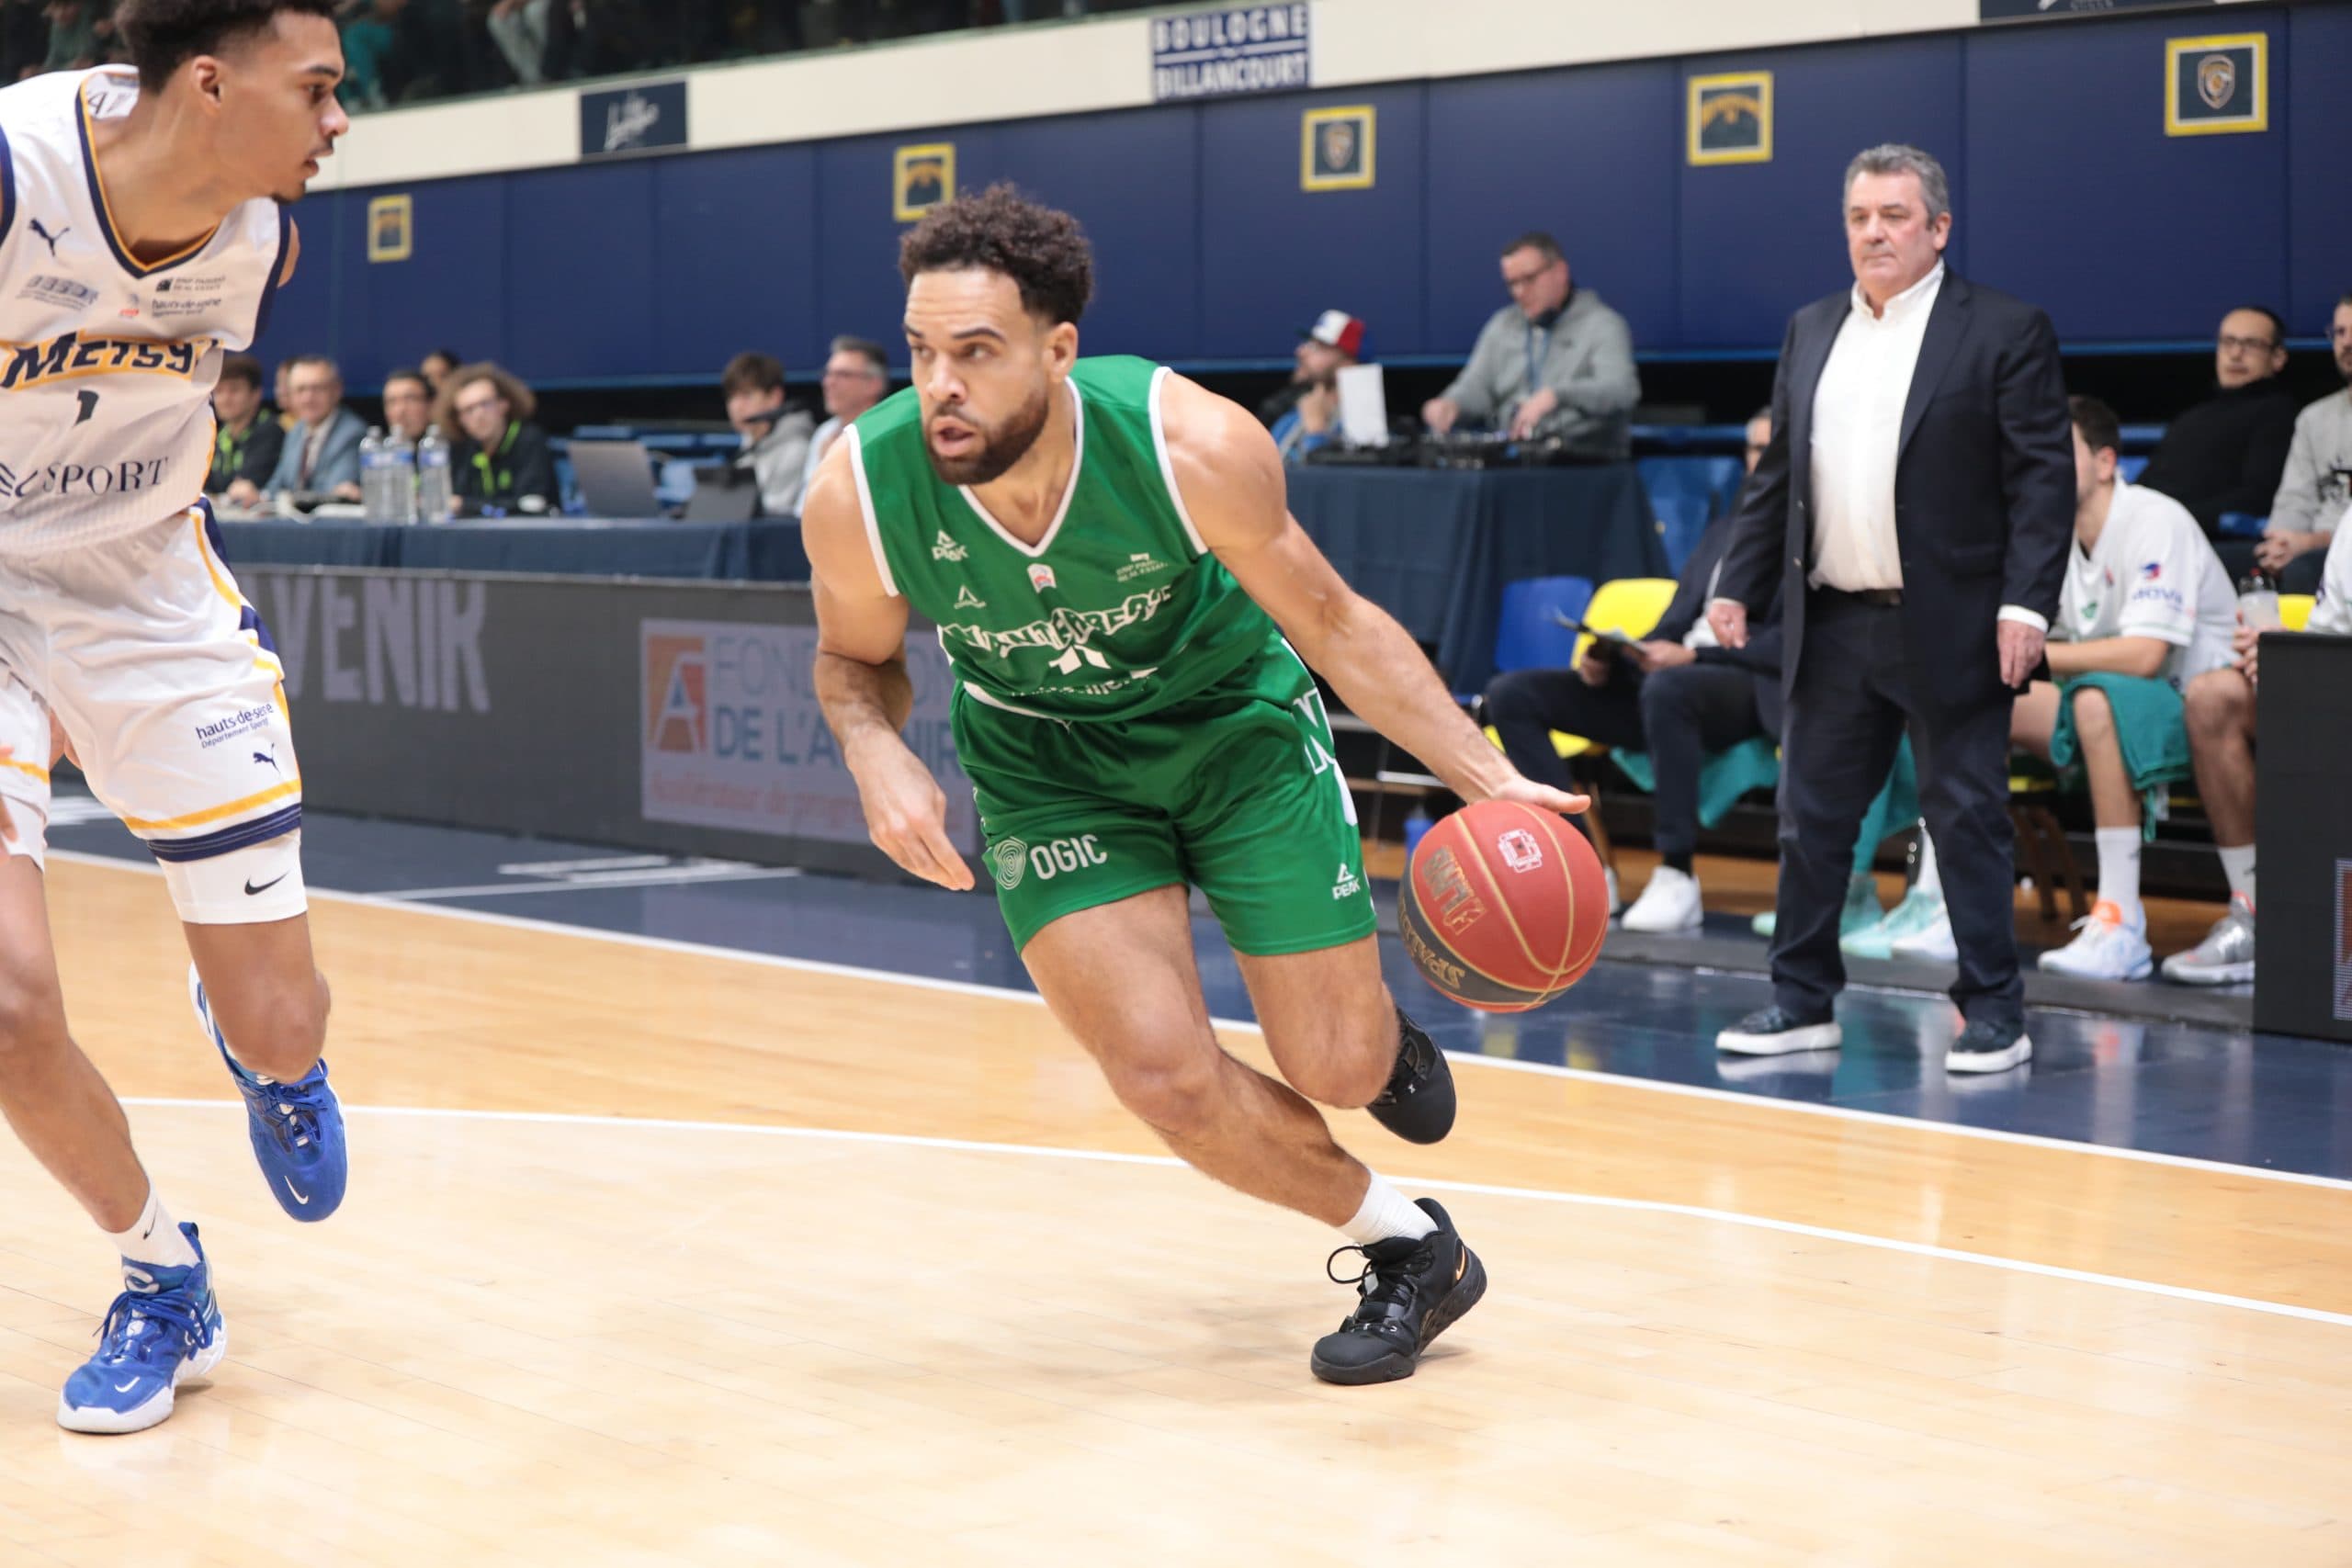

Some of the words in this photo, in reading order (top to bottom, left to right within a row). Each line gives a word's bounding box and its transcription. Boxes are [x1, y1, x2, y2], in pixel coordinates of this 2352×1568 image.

[1155, 3, 1306, 52] BOULOGNE
[1156, 51, 1306, 101] BILLANCOURT
[241, 576, 492, 714] VENIR
[713, 705, 763, 762] DE
[1030, 834, 1108, 880] OGIC
[1332, 878, 1362, 899] PEAK
